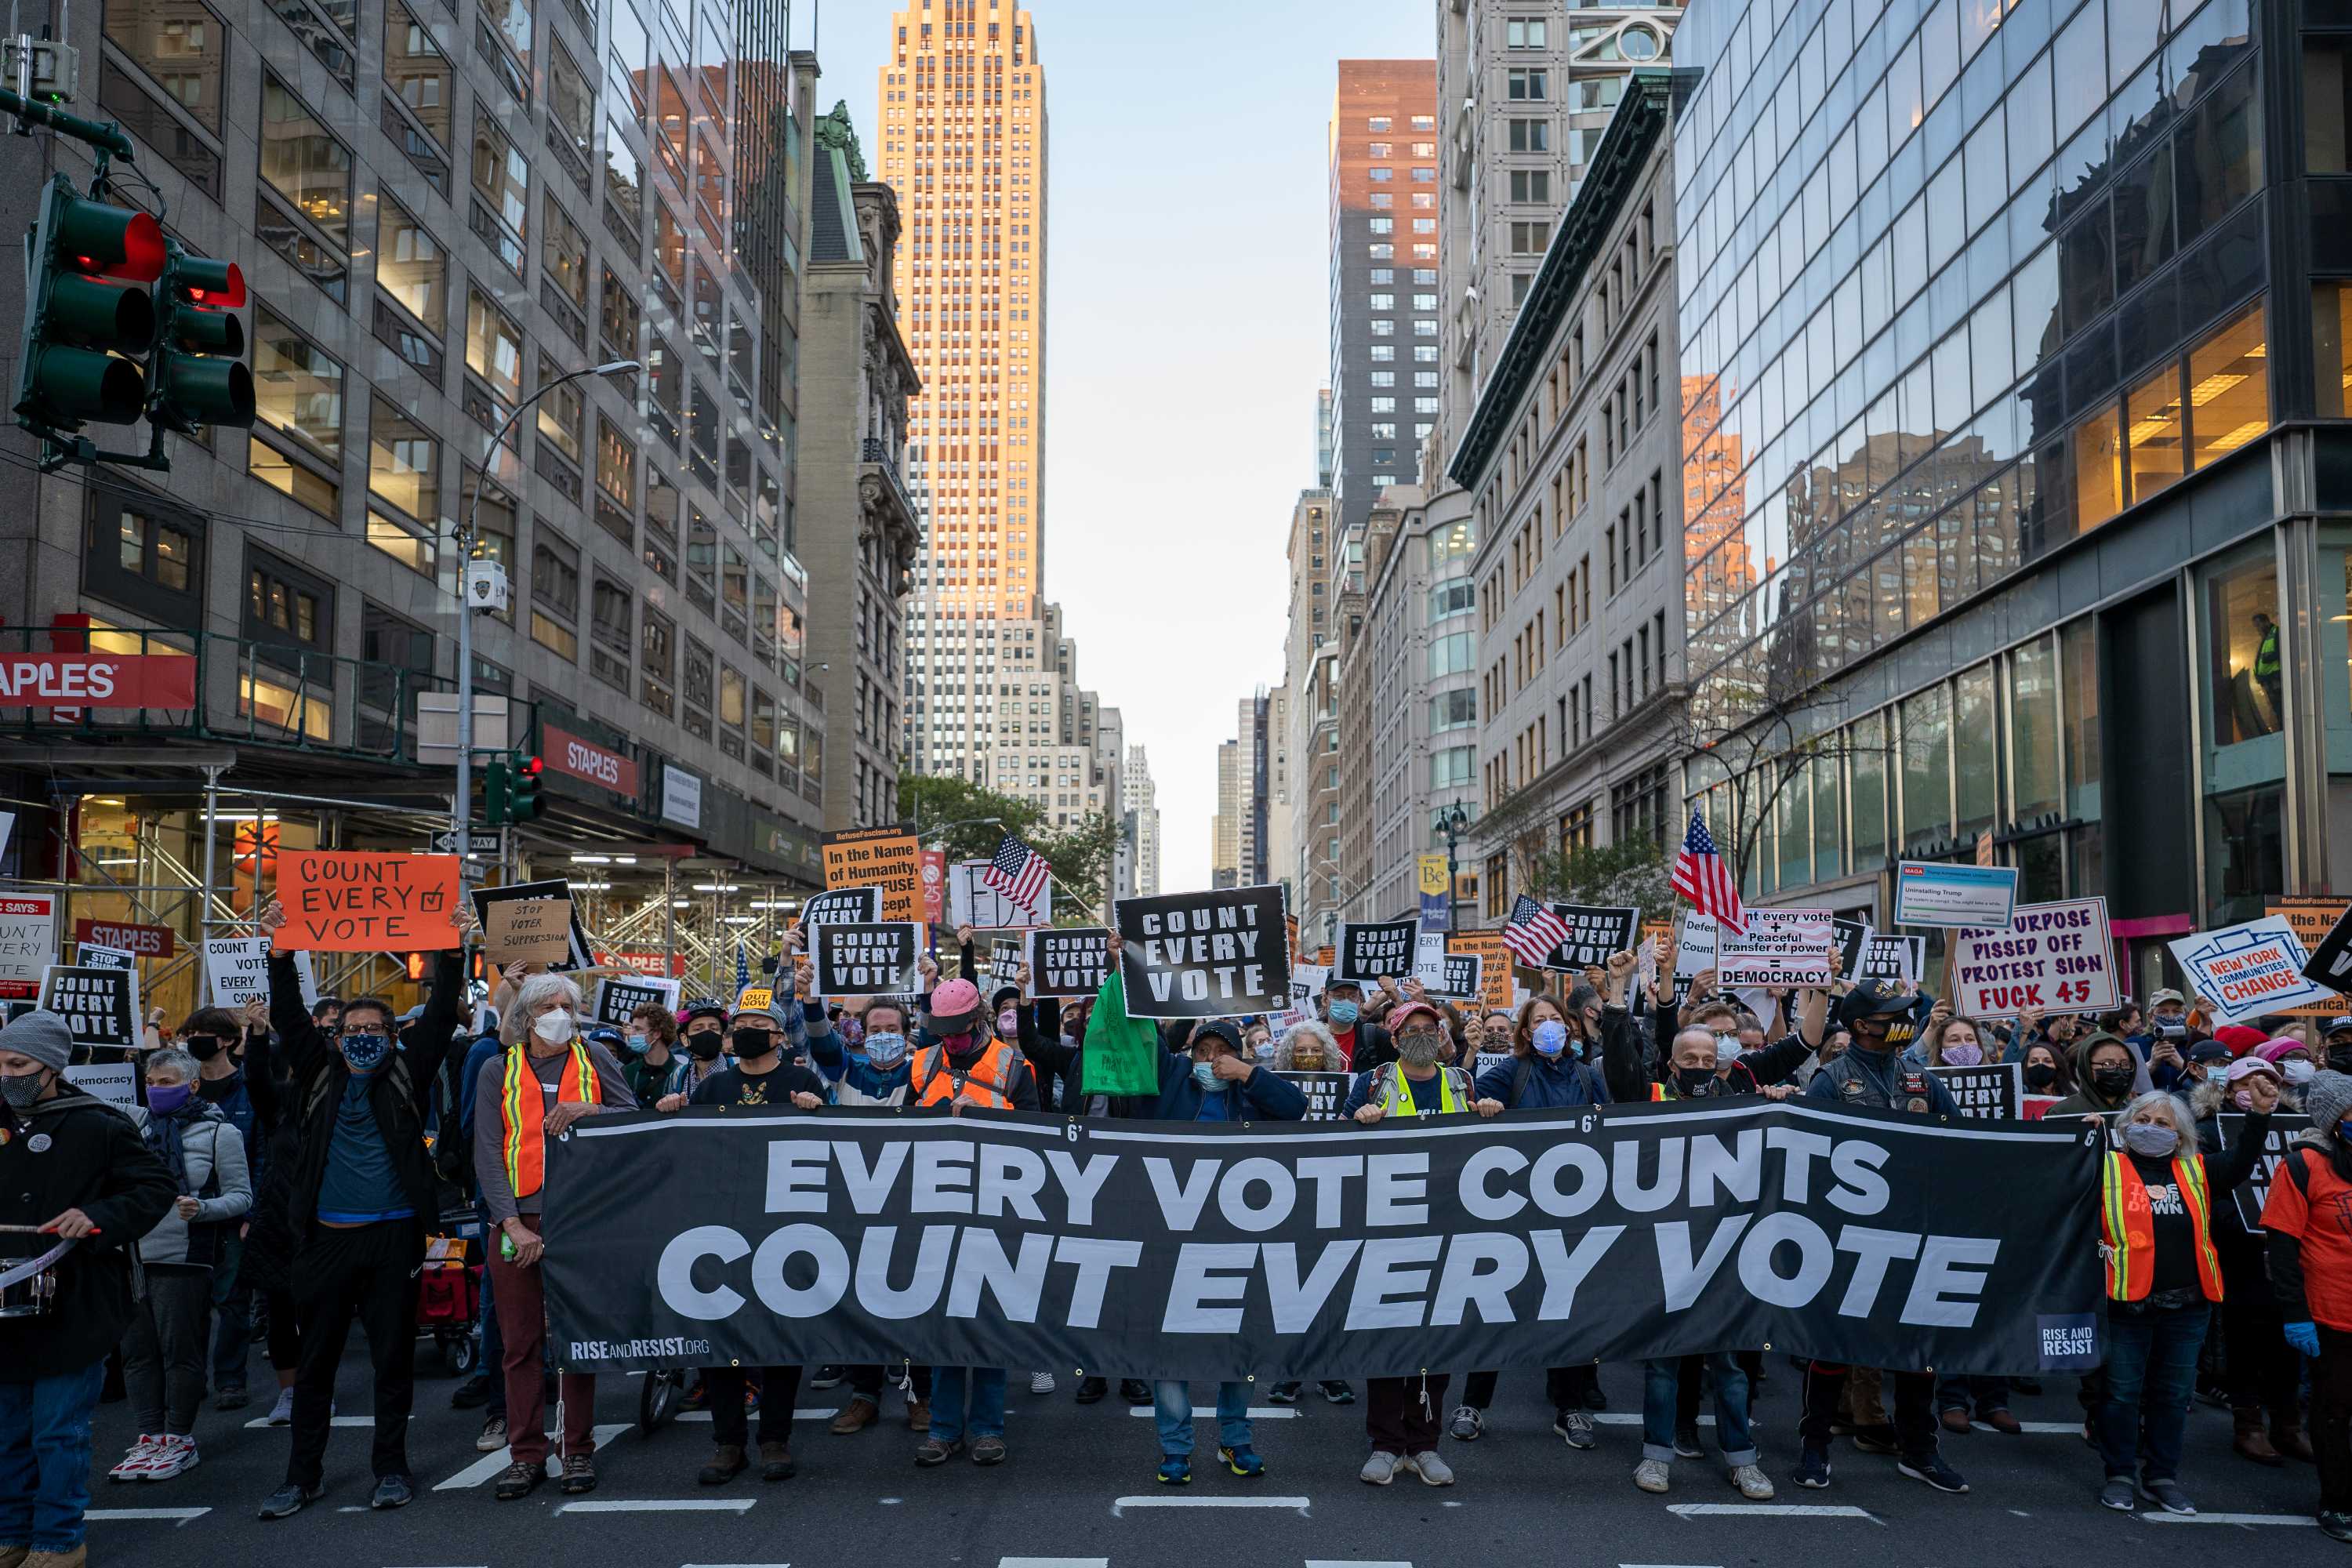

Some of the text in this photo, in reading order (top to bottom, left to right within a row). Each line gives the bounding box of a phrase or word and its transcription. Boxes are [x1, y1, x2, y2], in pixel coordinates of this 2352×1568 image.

[568, 742, 618, 784] STAPLES
[836, 828, 902, 840] RefuseFascism.org
[442, 837, 492, 848] ON WAY
[829, 851, 843, 864] In
[847, 848, 869, 862] the
[874, 845, 914, 859] Name
[300, 858, 408, 883] COUNT
[830, 862, 918, 881] of Humanity,
[862, 878, 916, 894] FUSE
[924, 885, 941, 902] 25
[1905, 887, 1941, 895] Uninstalling
[302, 885, 414, 913] EVERY
[813, 896, 863, 910] COUNT
[5, 902, 38, 913] SAYS:
[514, 906, 543, 915] STOP
[511, 918, 543, 930] VOTER
[809, 909, 862, 924] EVERY
[1142, 905, 1258, 935] COUNT
[1566, 914, 1624, 928] COUNT
[1763, 912, 1799, 923] every
[1802, 912, 1831, 922] vote
[2005, 909, 2092, 935] URPOSE
[2291, 913, 2315, 926] the
[305, 916, 409, 942] VOTE
[1356, 928, 1408, 942] COUNT
[91, 926, 161, 953] STAPLES
[504, 934, 567, 946] SUPPRESSION
[833, 932, 901, 946] COUNT
[1045, 938, 1107, 951] COUNT
[1749, 933, 1802, 942] Peaceful
[0, 942, 41, 956] ERY
[209, 942, 249, 954] COUNT
[1145, 931, 1259, 967] EVERY
[1356, 941, 1406, 957] EVERY
[1453, 941, 1502, 951] In the Nam
[1682, 942, 1715, 954] Count
[1723, 942, 1828, 954] transfer of power
[1973, 933, 2082, 960] PISSED OFF
[92, 953, 120, 965] STOP
[833, 947, 900, 964] EVERY
[1045, 951, 1107, 967] EVERY
[2209, 947, 2283, 976] NEW YORK
[236, 958, 269, 970] VOTE
[1355, 956, 1405, 975] VOTE
[1961, 954, 2103, 984] PROTEST SIGN
[833, 966, 900, 985] VOTE
[1046, 969, 1108, 988] VOTE
[1722, 971, 1828, 983] DEMOCRACY
[2218, 961, 2285, 985] COMMUNITIES
[55, 977, 115, 993] COUNT
[220, 976, 256, 988] EVERY
[1147, 964, 1265, 1002] VOTE
[2223, 970, 2300, 1001] CHANGE
[52, 993, 116, 1012] EVERY
[612, 988, 657, 1002] COUNT
[1979, 980, 2090, 1010] FUCK 45
[71, 1075, 133, 1086] democracy
[1940, 1074, 2002, 1090] COUNT
[764, 1127, 1891, 1232] EVERY VOTE COUNTS
[2130, 1192, 2180, 1203] TRMP
[657, 1211, 2001, 1334] COUNT EVERY VOTE
[2043, 1327, 2092, 1341] RISE AND
[571, 1337, 710, 1360] RISEANDRESIST.ORG
[2044, 1339, 2093, 1356] RESIST
